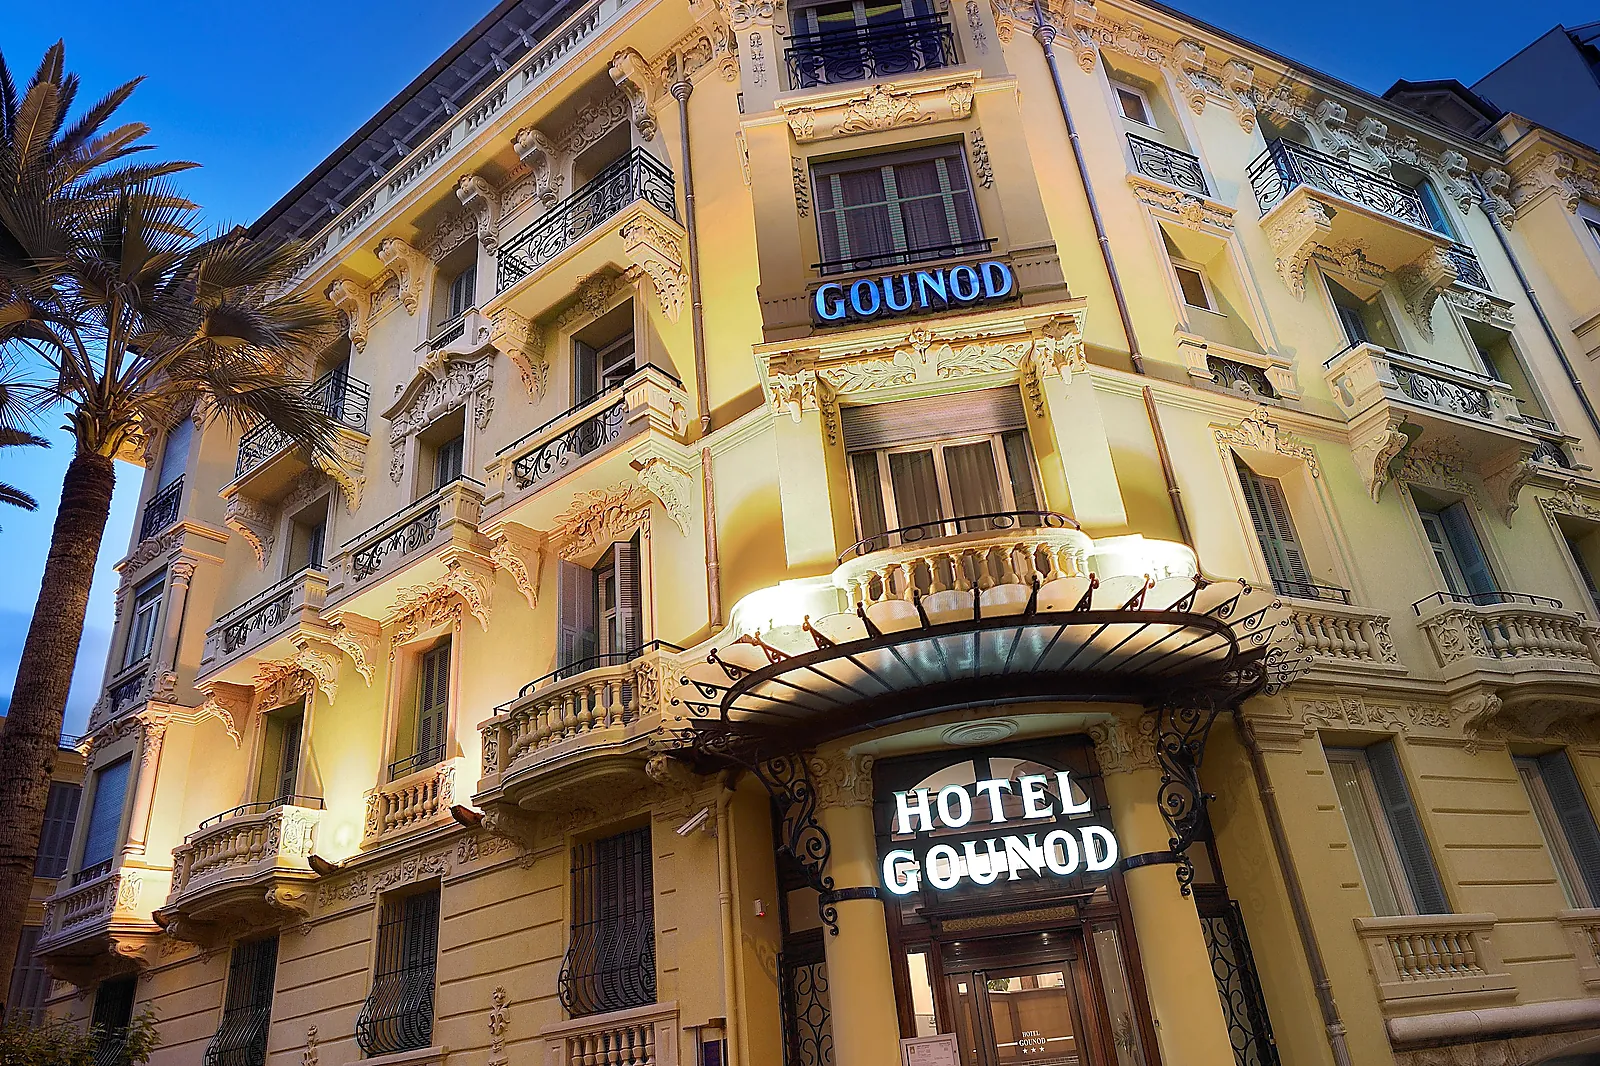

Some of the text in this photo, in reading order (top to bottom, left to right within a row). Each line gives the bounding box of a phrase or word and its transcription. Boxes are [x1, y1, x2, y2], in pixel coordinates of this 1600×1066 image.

[815, 261, 1013, 320] GOUNOD
[893, 771, 1091, 834] HOTEL
[883, 825, 1119, 895] GOUNOD
[1019, 1037, 1046, 1047] GOUNOD
